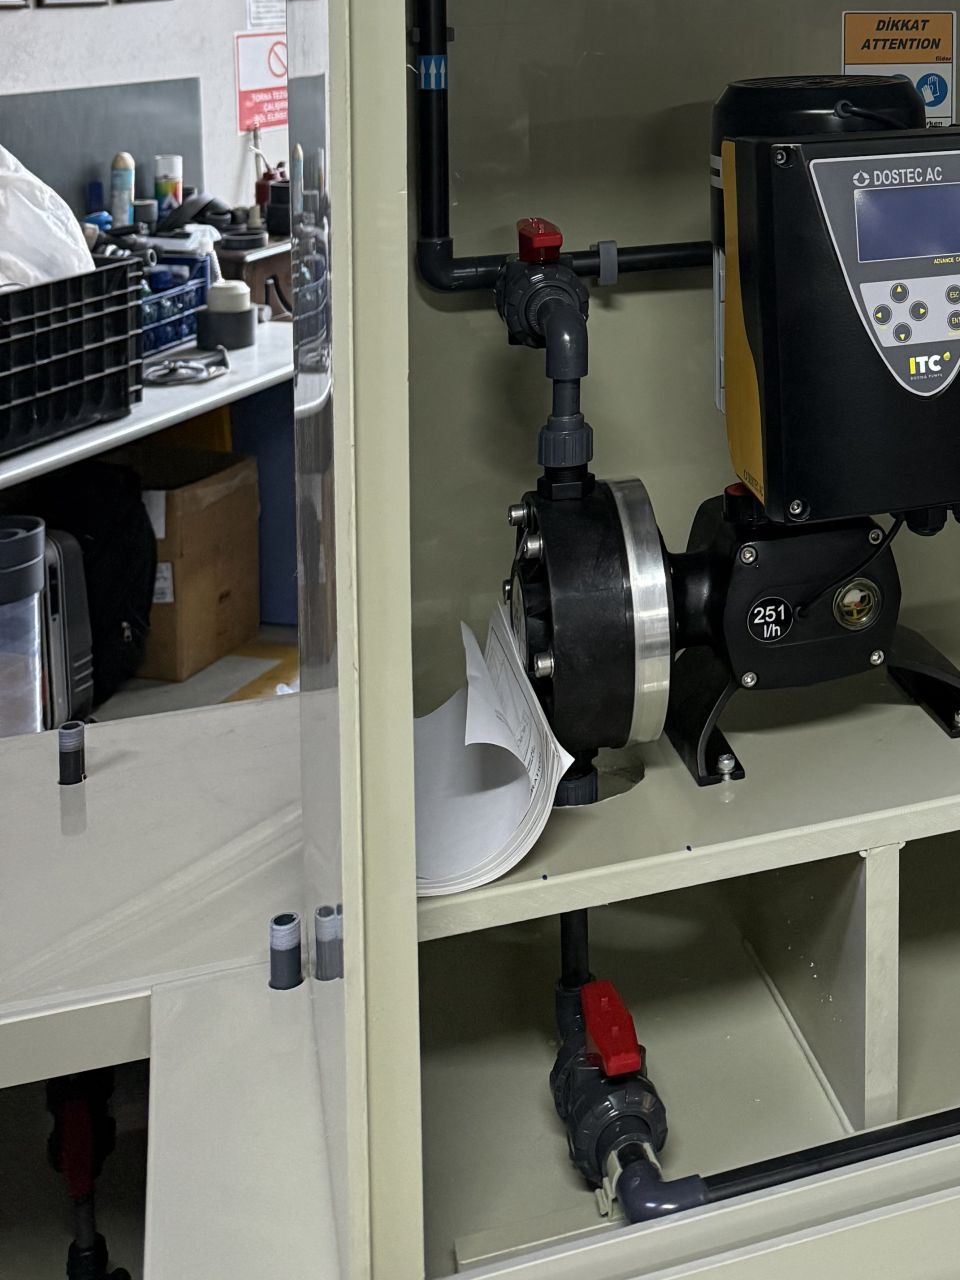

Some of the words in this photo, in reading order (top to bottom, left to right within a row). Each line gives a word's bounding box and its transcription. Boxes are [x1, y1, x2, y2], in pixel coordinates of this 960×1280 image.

[875, 16, 930, 32] DİKKAT
[861, 38, 942, 51] ATTENTION
[873, 168, 923, 186] DOSTEC
[925, 166, 943, 182] AC
[949, 290, 960, 299] ESC
[909, 354, 942, 375] ITC
[753, 603, 786, 624] 251
[763, 623, 781, 638] l/h
